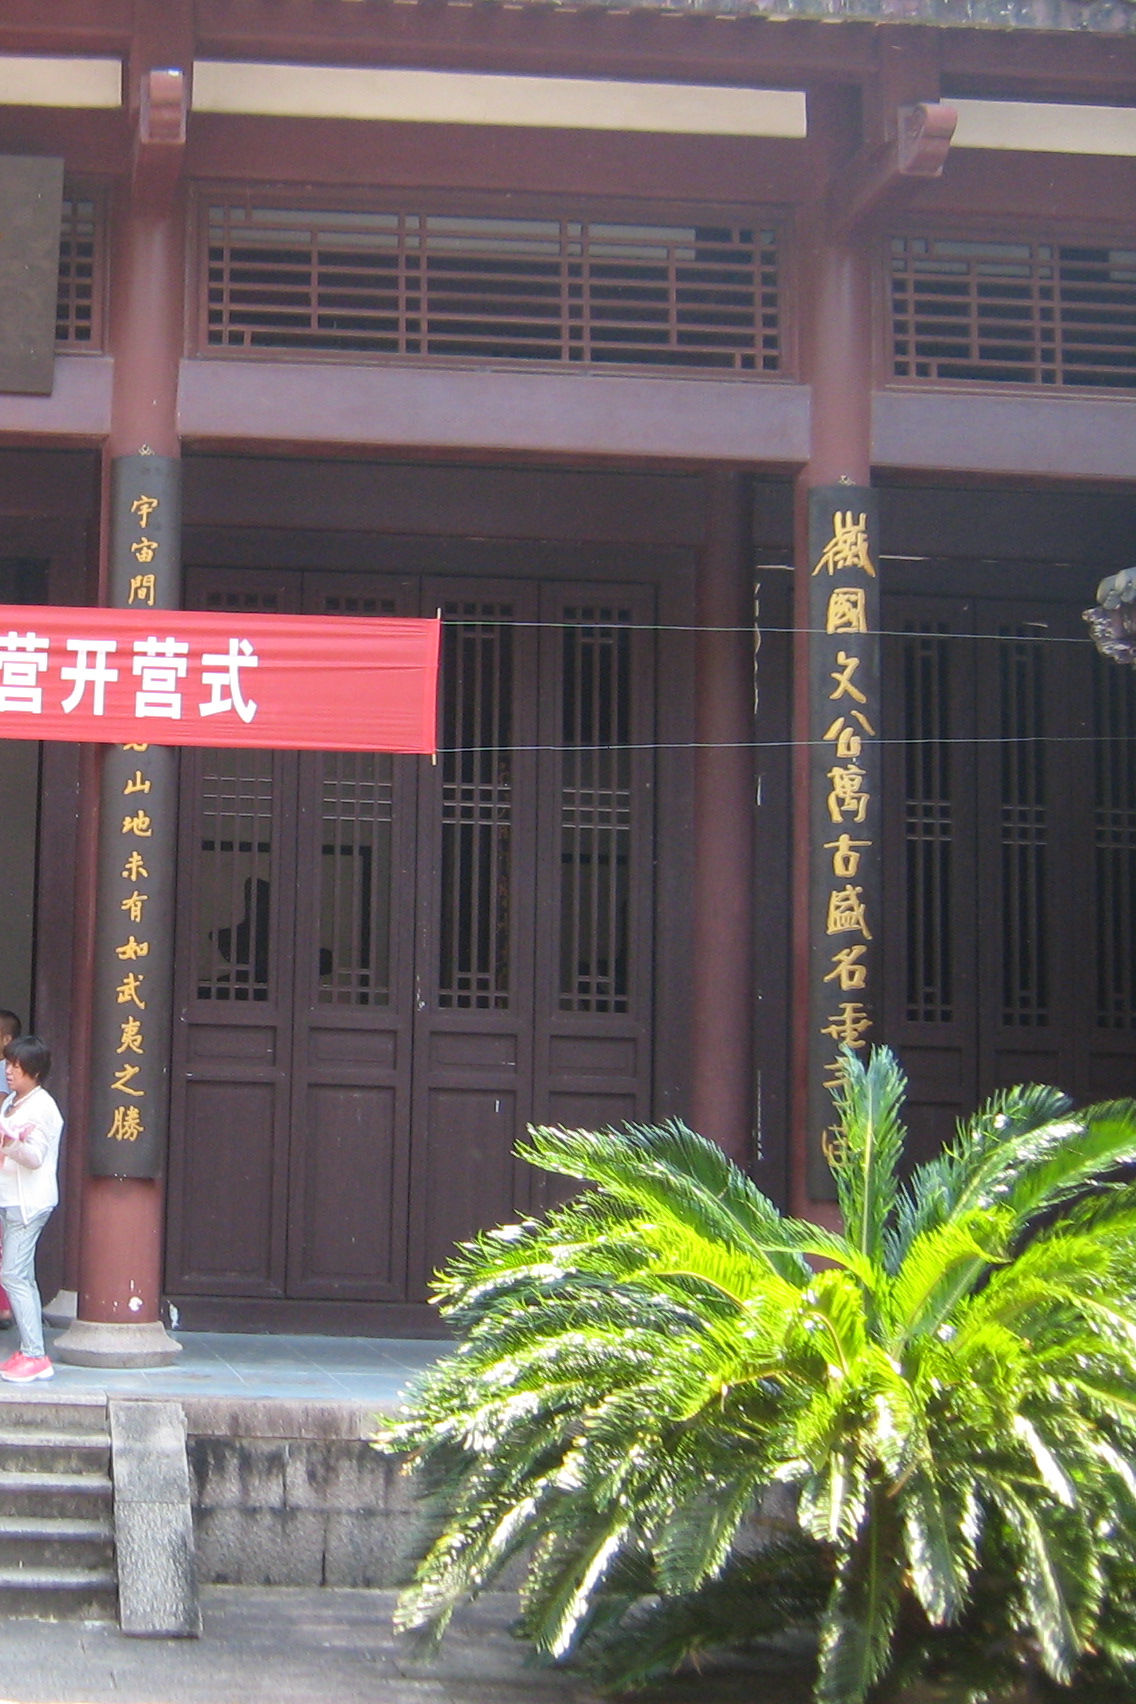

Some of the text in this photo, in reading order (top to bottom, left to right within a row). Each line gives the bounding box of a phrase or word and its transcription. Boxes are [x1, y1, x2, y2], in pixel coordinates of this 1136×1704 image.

[108, 743, 154, 1142] 山地未有如武夷之勝
